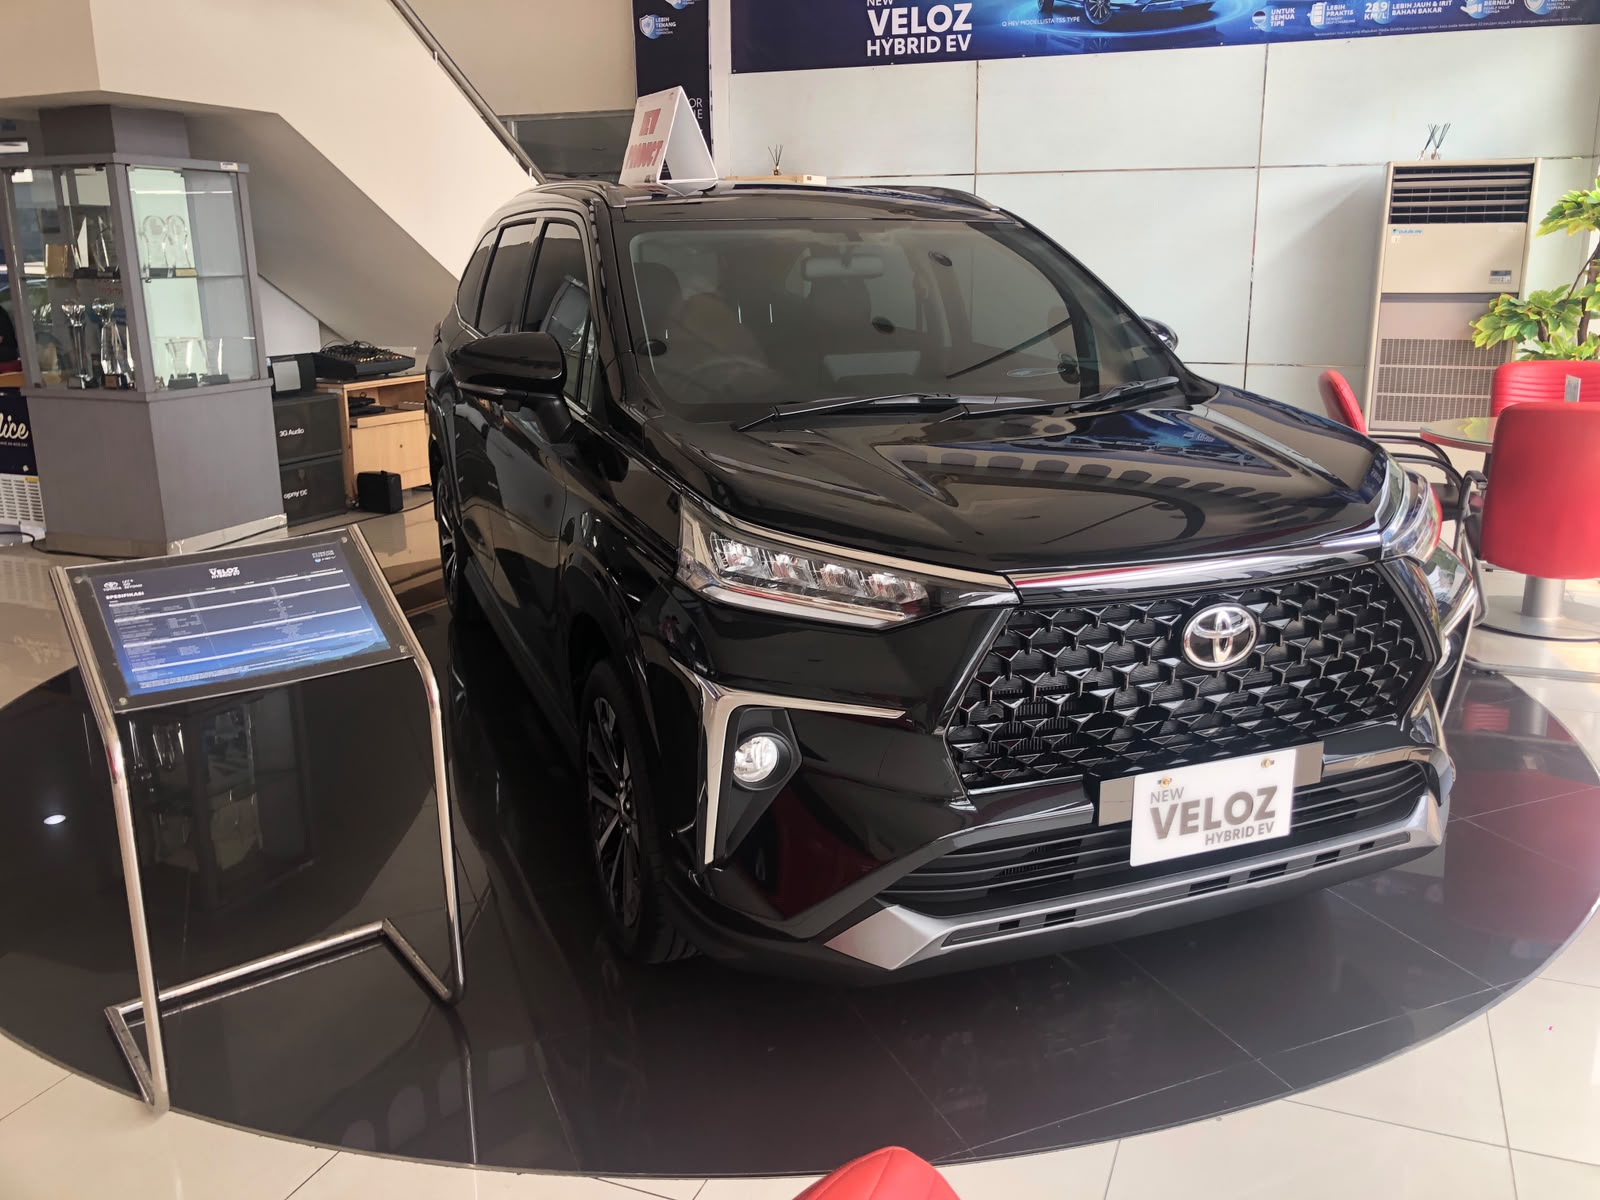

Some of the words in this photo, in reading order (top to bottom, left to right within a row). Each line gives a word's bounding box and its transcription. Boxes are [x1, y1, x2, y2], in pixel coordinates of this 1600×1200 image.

[867, 3, 972, 36] VELOZ
[866, 36, 941, 57] HYBRID
[946, 34, 972, 52] EV
[1150, 786, 1185, 804] NEW
[1150, 786, 1277, 839] VELOZ
[1205, 825, 1255, 846] HYBRID
[1257, 821, 1275, 836] EV
